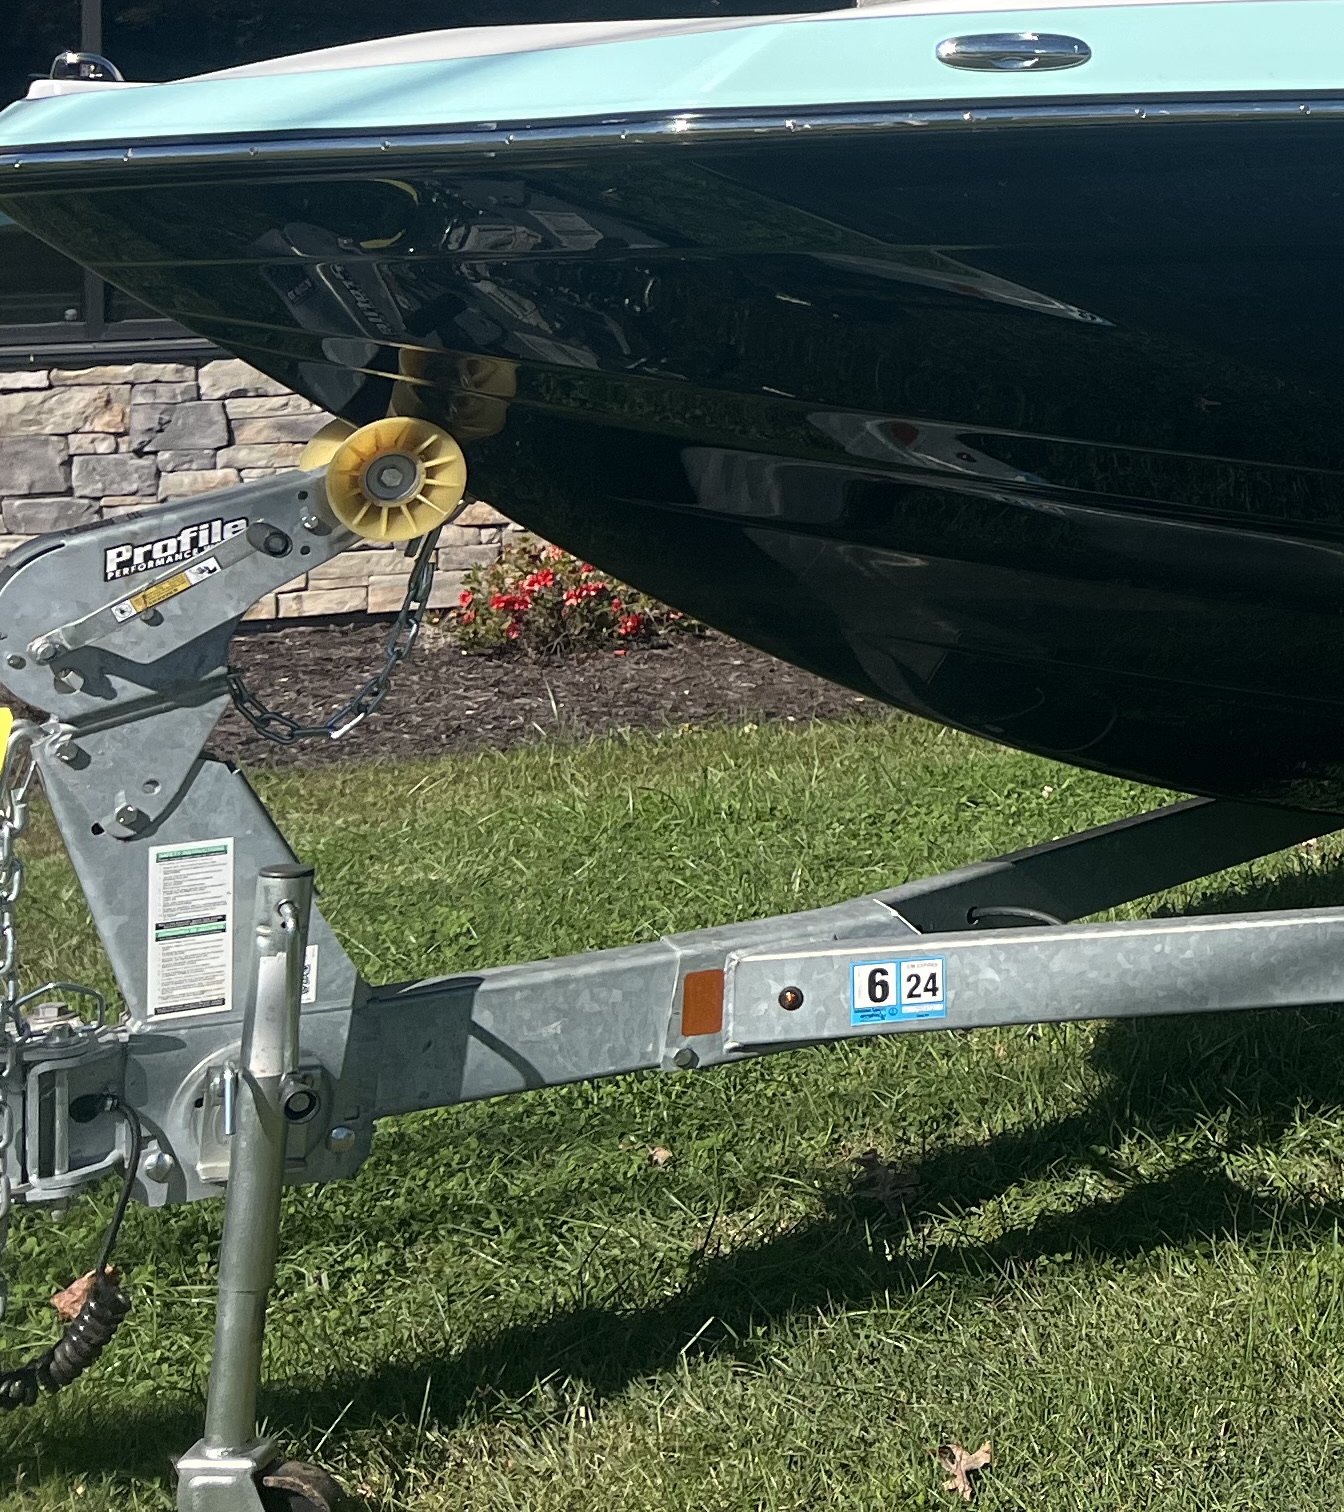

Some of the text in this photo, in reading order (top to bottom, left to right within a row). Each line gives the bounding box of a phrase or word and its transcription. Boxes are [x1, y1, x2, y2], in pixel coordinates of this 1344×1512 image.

[106, 518, 248, 572] Profile
[107, 549, 200, 580] PERFORMANCE
[867, 967, 890, 1003] 6
[906, 972, 940, 999] 24
